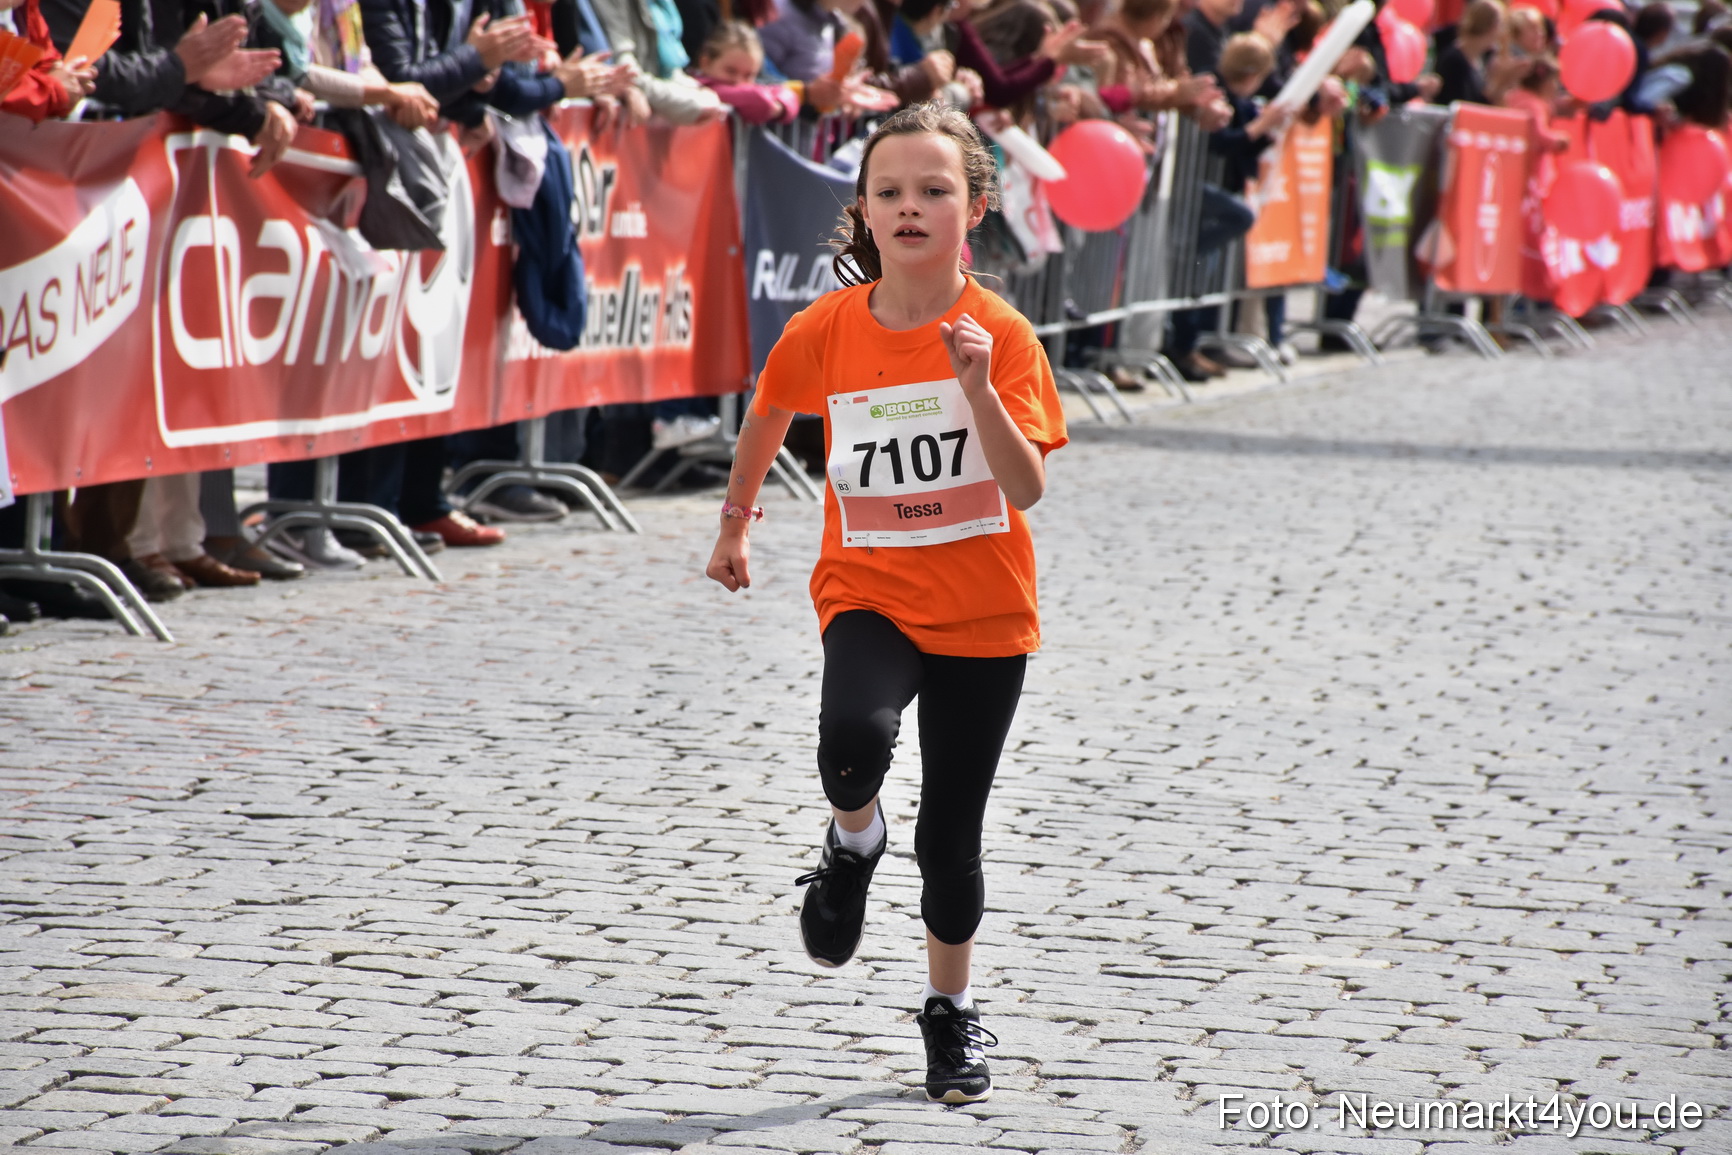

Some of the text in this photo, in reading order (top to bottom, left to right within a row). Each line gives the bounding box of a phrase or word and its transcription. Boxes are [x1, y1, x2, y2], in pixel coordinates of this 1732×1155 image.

[72, 218, 135, 336] NEUE
[885, 397, 941, 416] BOCK
[853, 428, 968, 488] 7107
[838, 483, 850, 491] B3
[893, 502, 942, 519] Tessa
